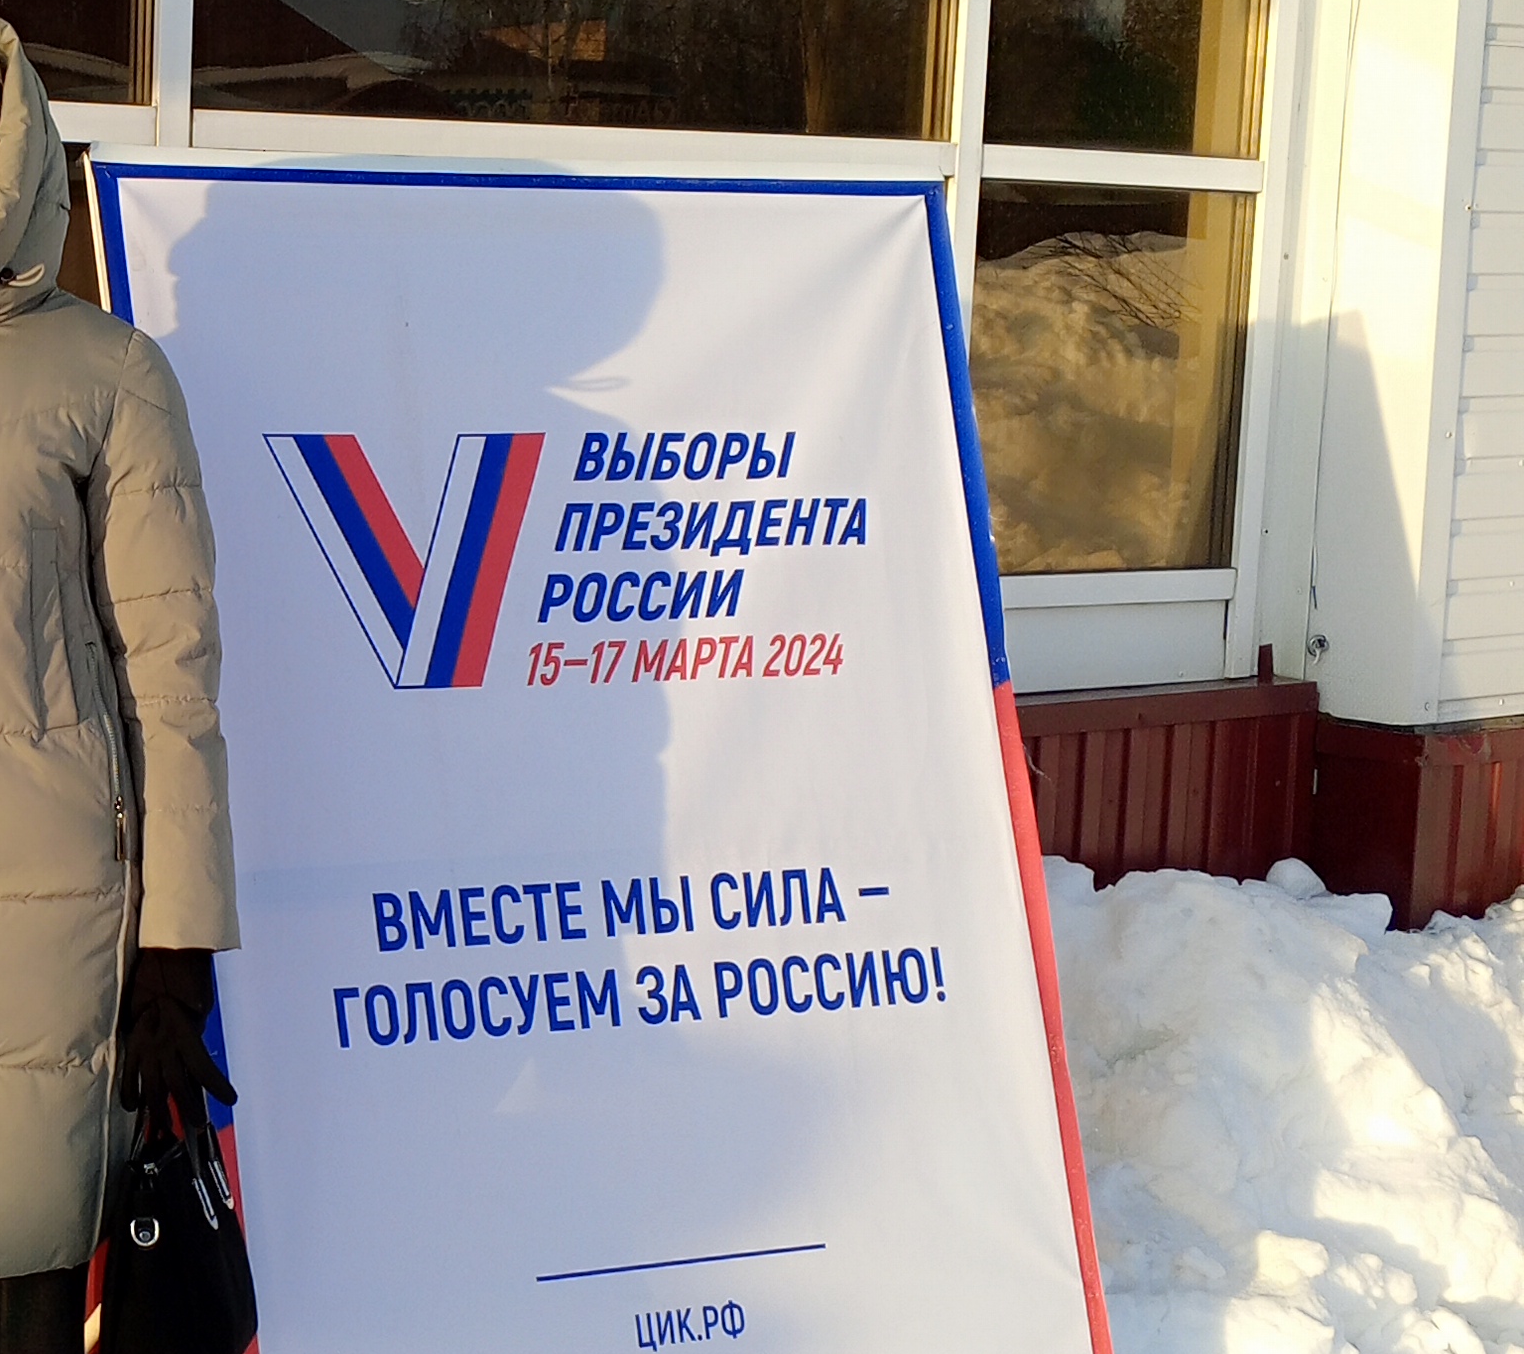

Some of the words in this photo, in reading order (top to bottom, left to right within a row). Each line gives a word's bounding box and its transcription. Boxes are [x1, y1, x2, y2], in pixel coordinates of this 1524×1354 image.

[574, 431, 796, 482] ВЫБОРЫ
[554, 498, 867, 556] ПРЕЗИДЕНТА
[538, 569, 745, 625] РОССИИ
[632, 635, 755, 683] МАРТА
[762, 633, 845, 678] 2024
[372, 881, 589, 954] ВМЕСТЕ
[601, 876, 695, 939] МЫ
[711, 867, 847, 931] СИЛА
[333, 969, 623, 1050] ГОЛОСУЕМ
[636, 965, 702, 1026] ЗА
[715, 947, 947, 1020] РОССИЮ!
[635, 1301, 746, 1352] ЦИК.РФ
